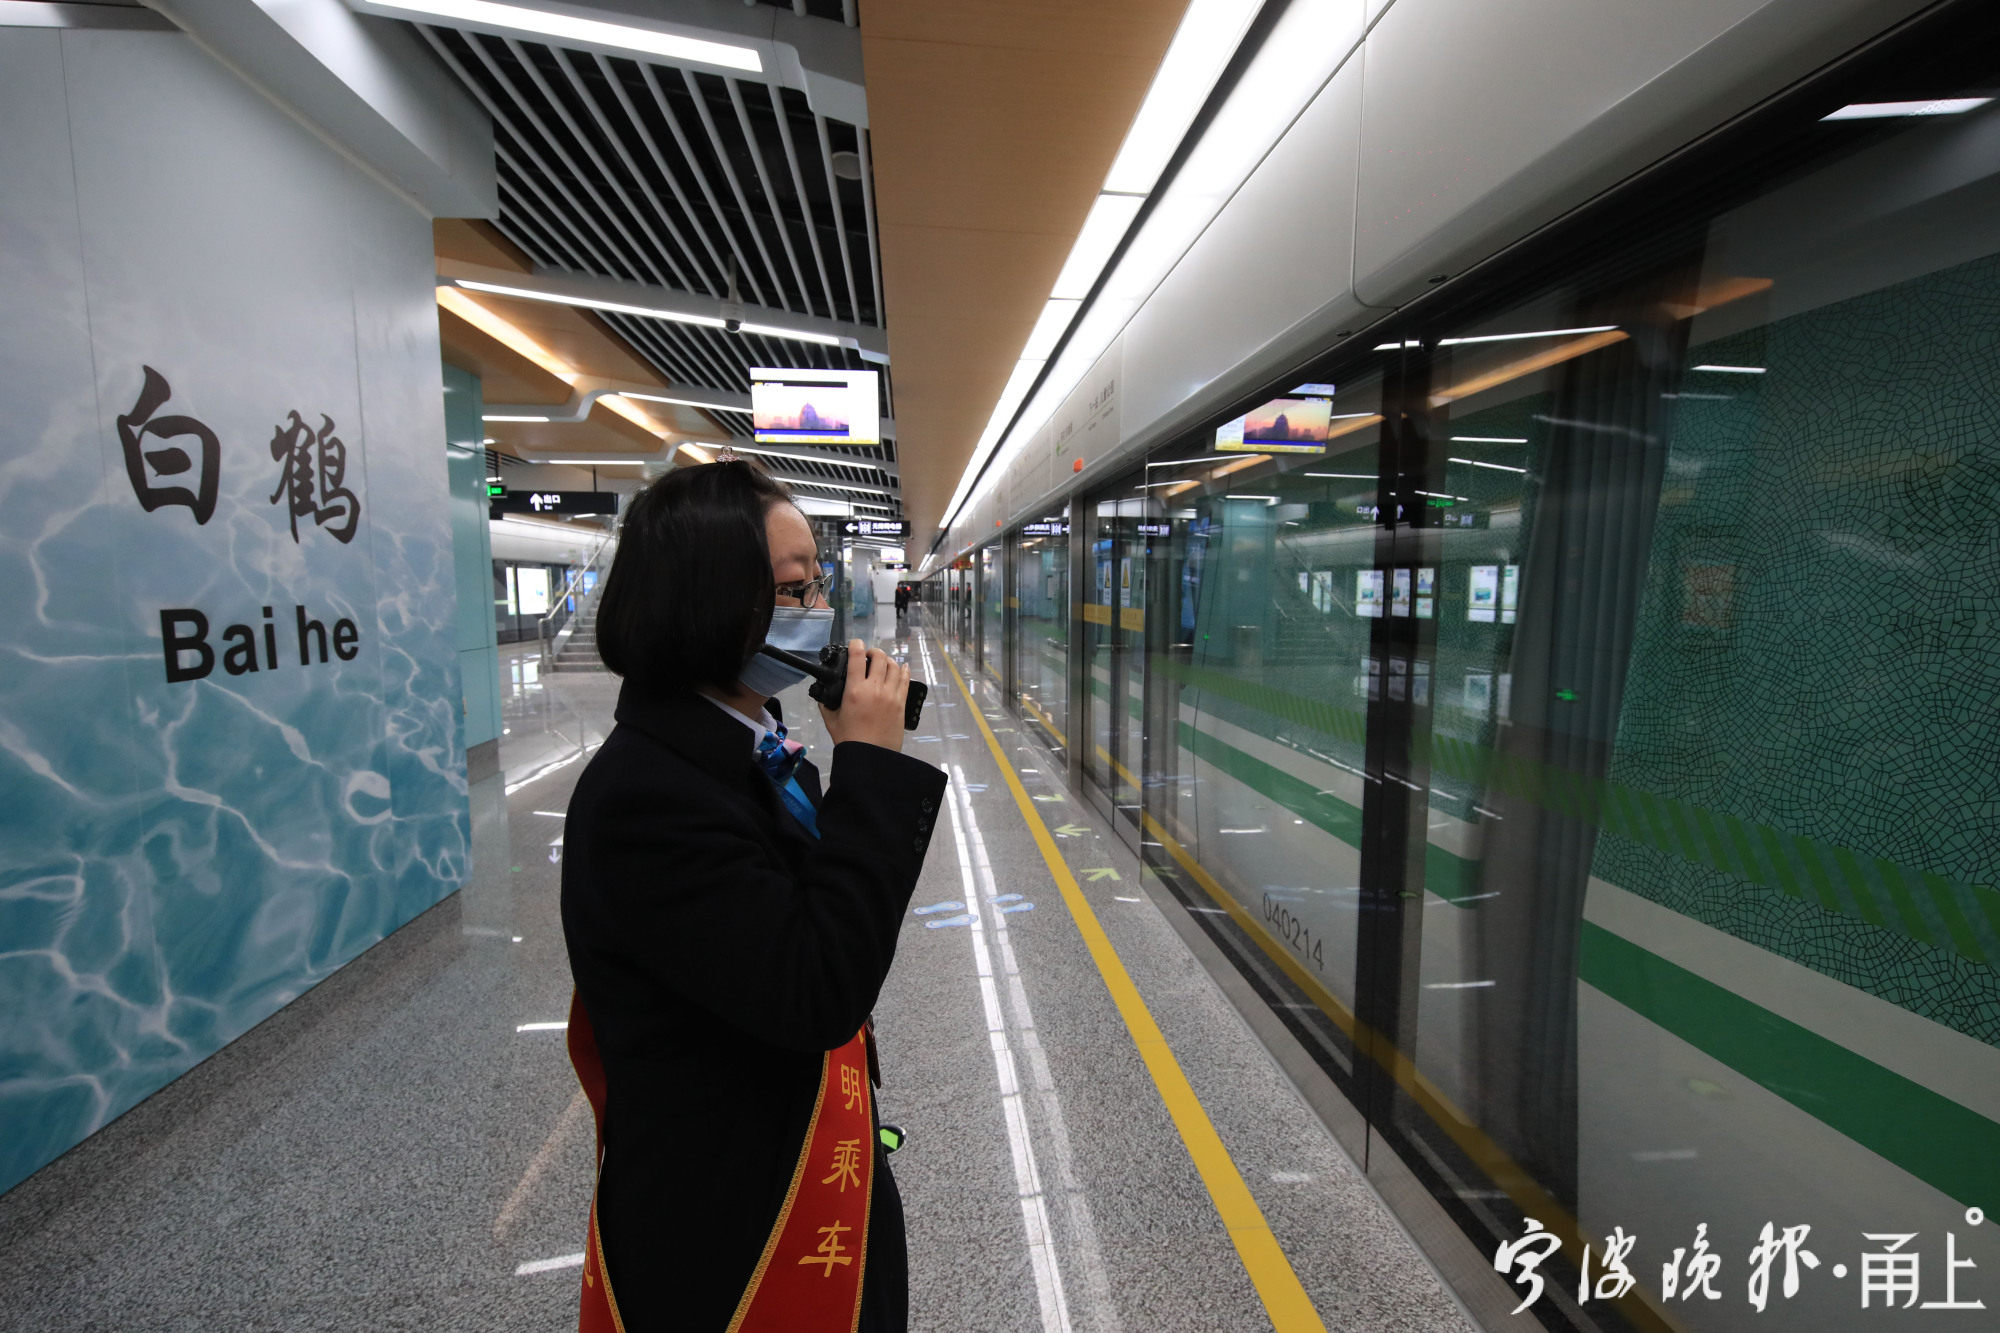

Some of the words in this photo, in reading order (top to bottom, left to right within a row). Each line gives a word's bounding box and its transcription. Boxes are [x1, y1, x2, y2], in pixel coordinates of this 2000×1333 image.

[117, 365, 360, 544] 白鹤
[1263, 892, 1324, 971] 040214
[799, 1029, 863, 1278] 明乘车
